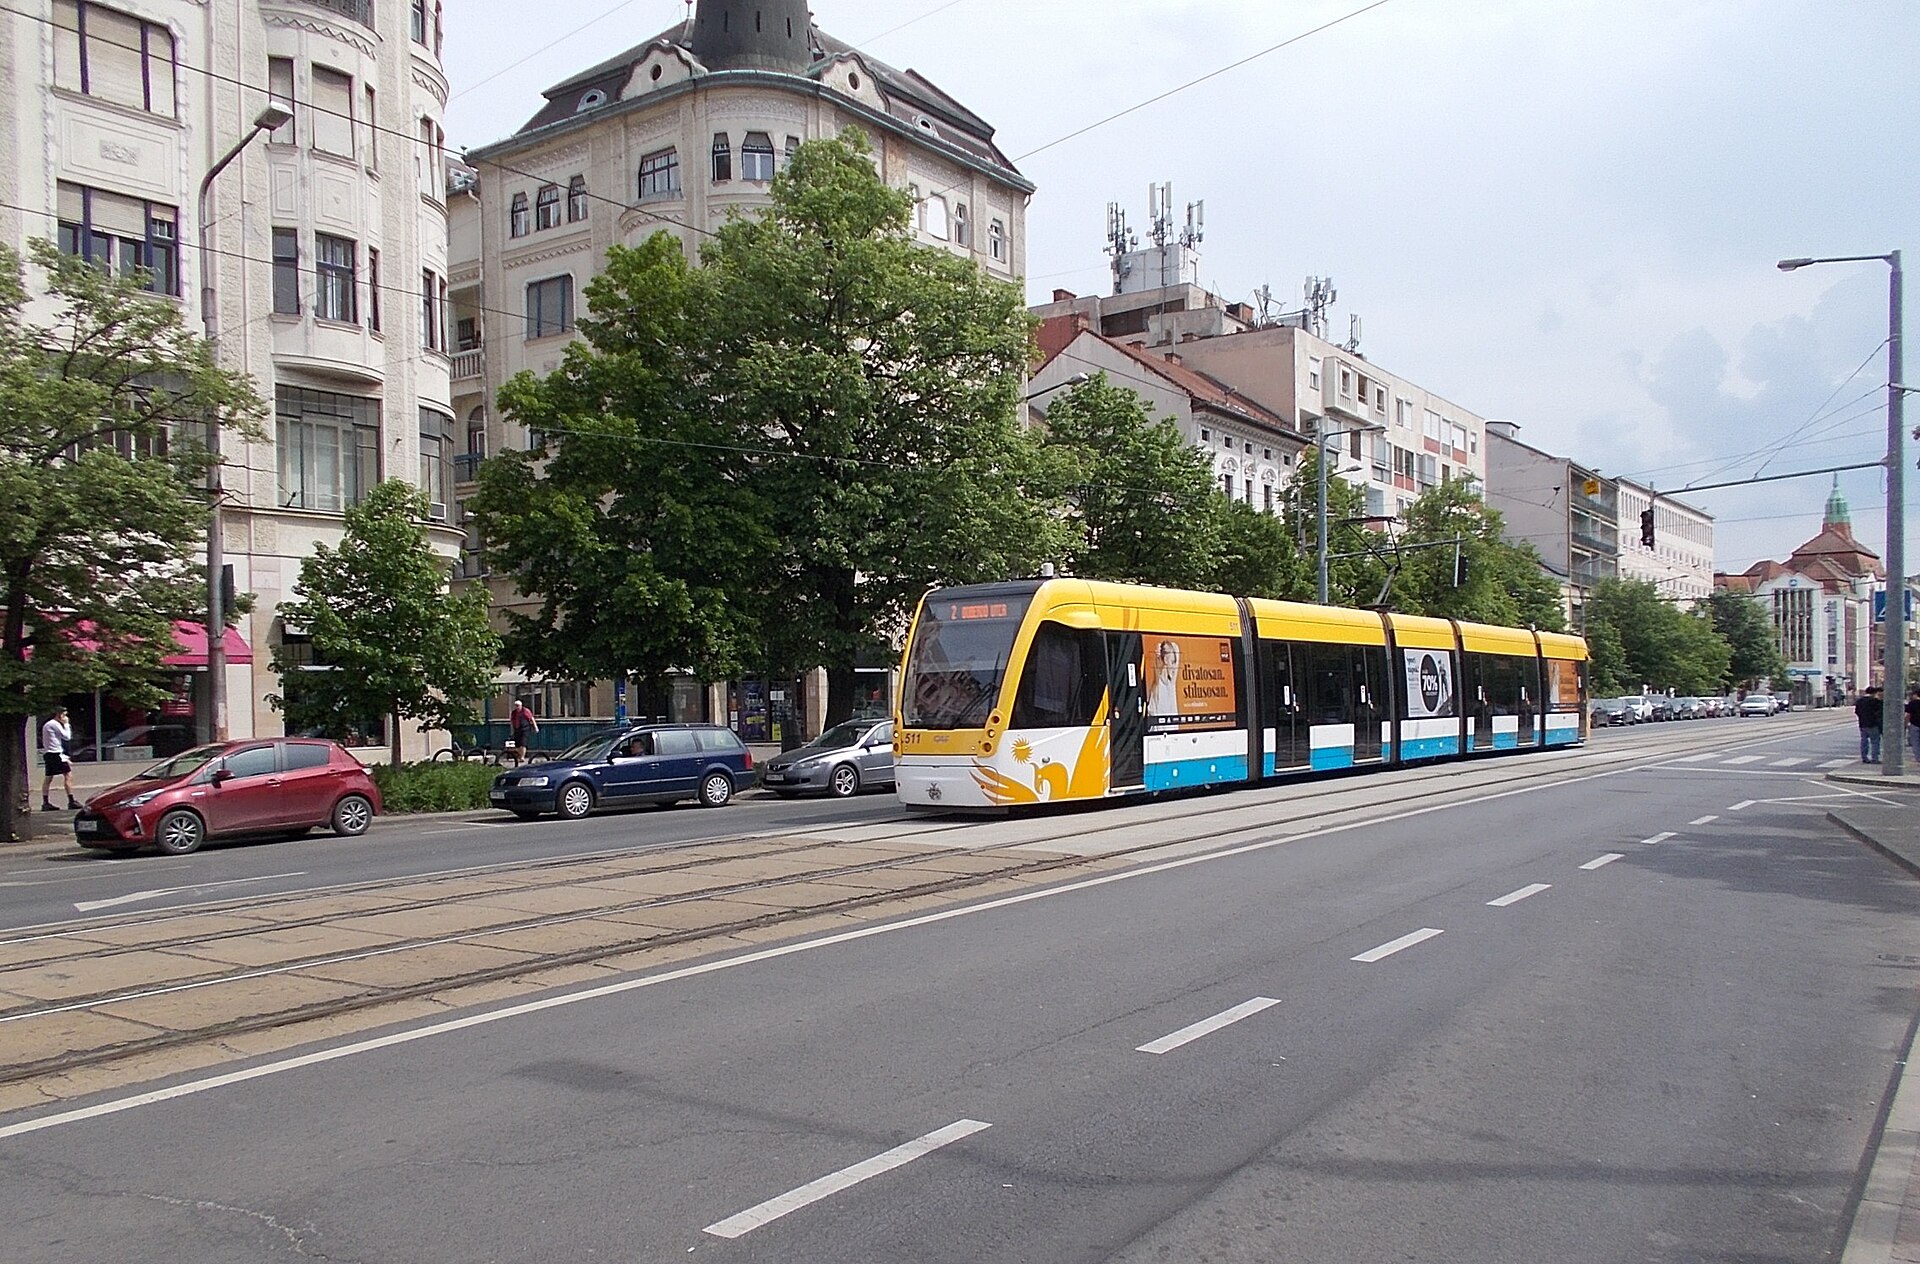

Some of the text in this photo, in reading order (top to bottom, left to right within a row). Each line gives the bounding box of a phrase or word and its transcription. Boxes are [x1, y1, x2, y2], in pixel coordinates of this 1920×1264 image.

[950, 605, 957, 620] 2
[1182, 664, 1225, 680] divatosan.
[1422, 674, 1438, 691] 70%
[905, 733, 920, 744] 511
